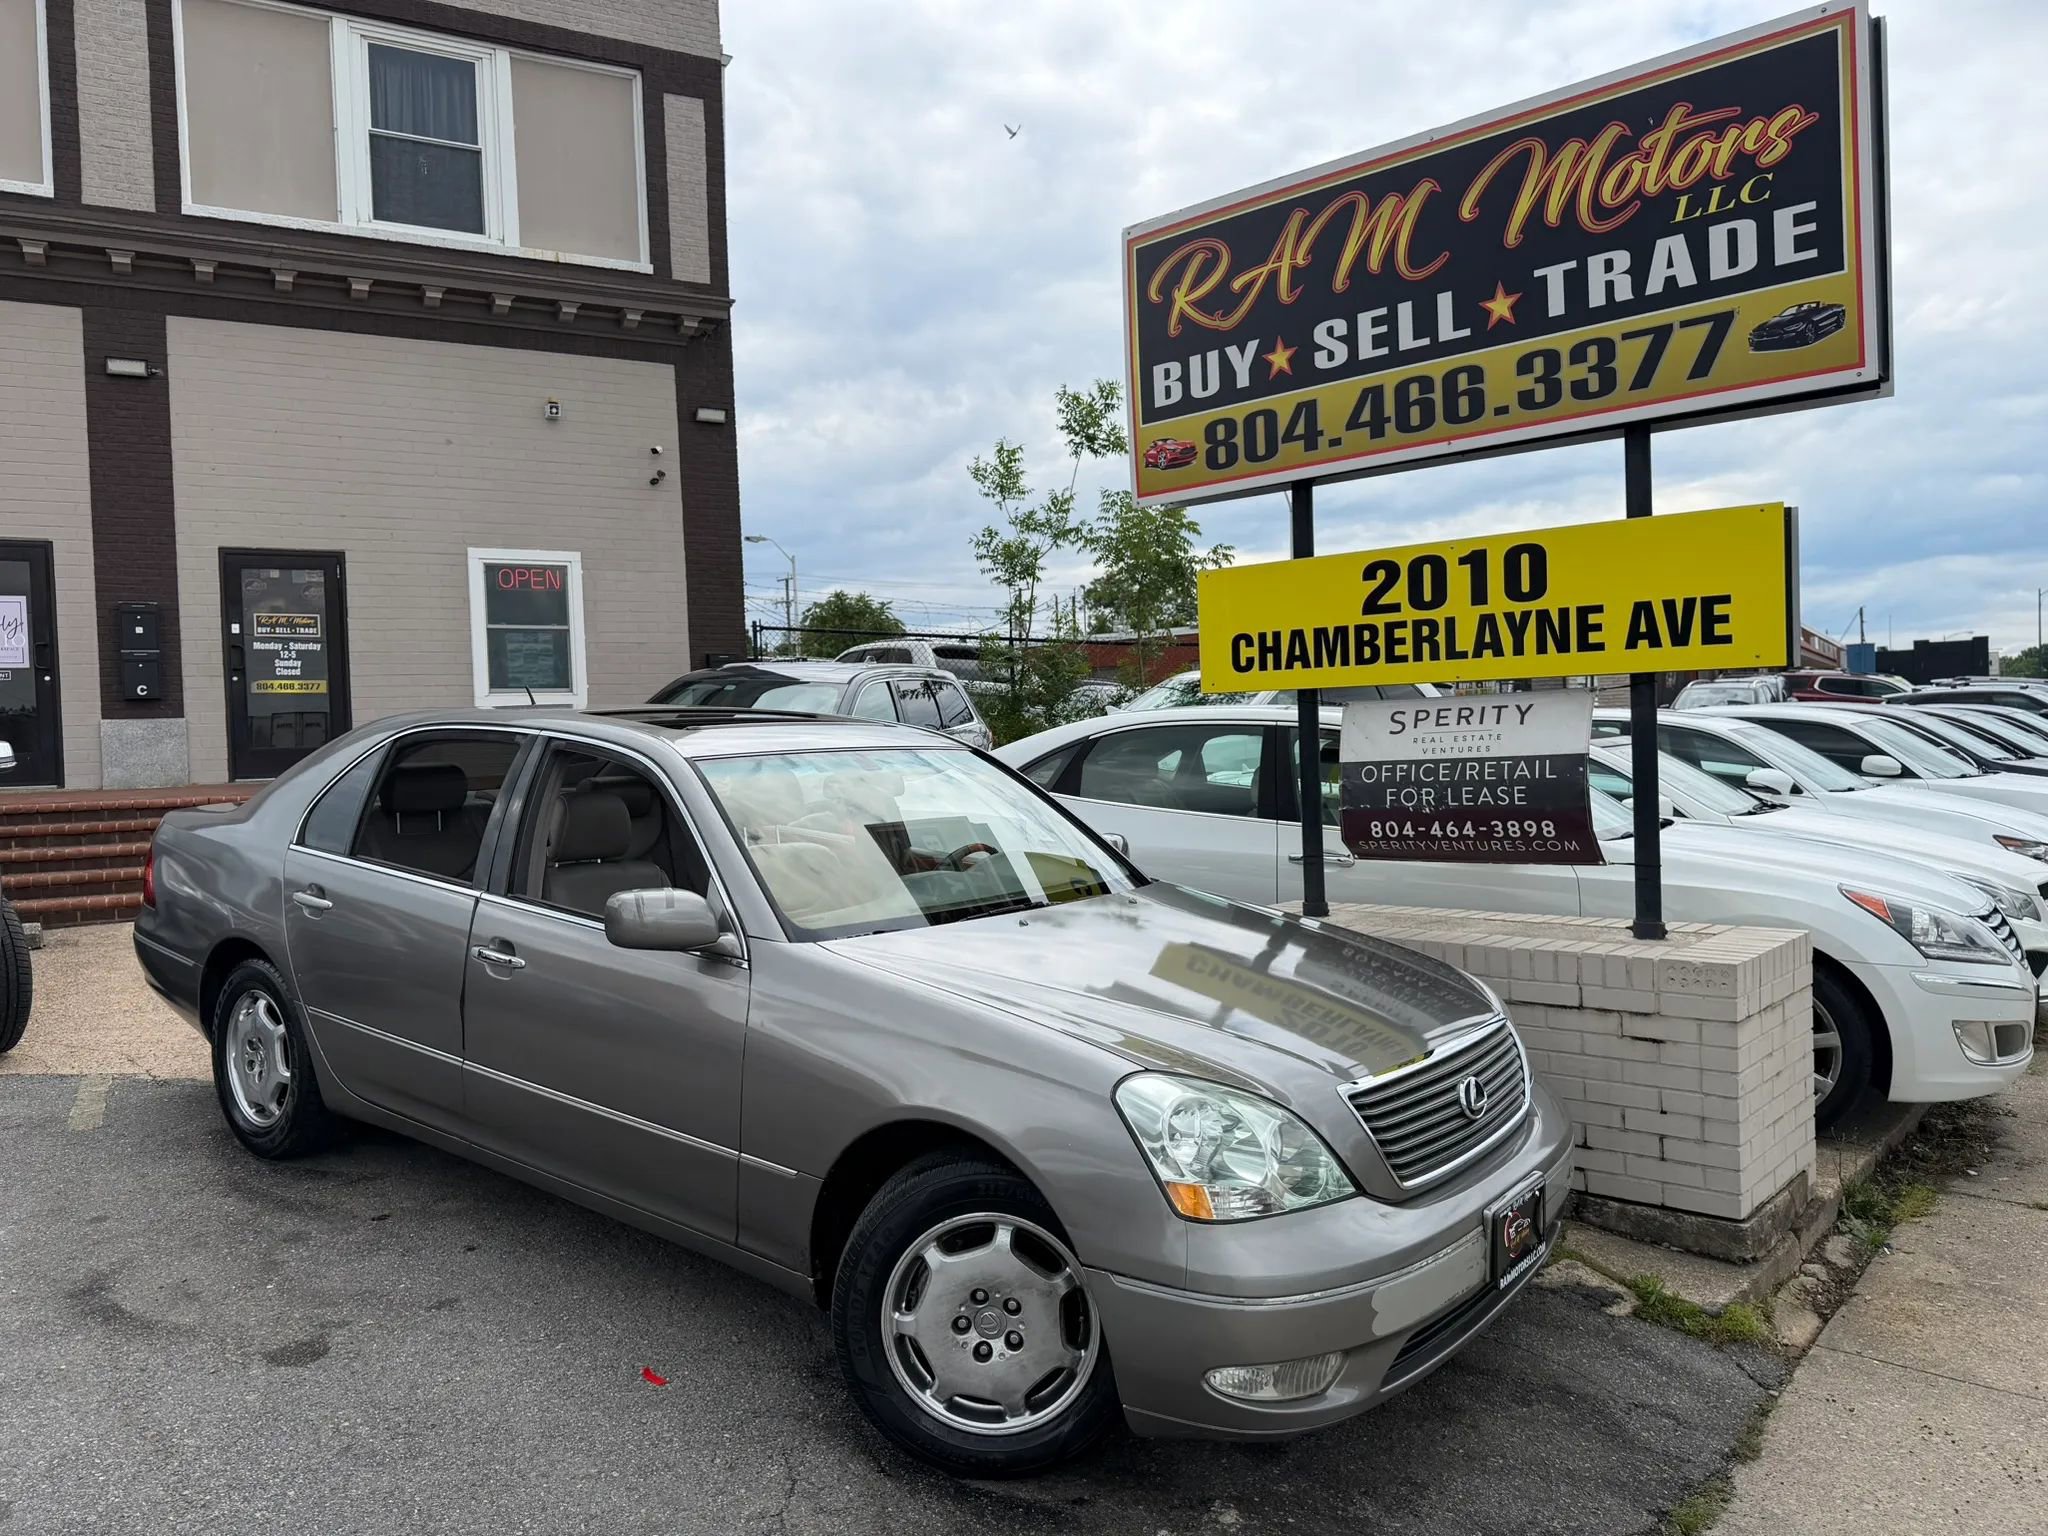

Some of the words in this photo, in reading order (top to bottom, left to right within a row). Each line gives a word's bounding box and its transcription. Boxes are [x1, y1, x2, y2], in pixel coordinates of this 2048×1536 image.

[1457, 102, 1819, 249] Motors
[1669, 173, 1775, 224] LLC
[1151, 339, 1260, 408] BUY
[1311, 291, 1472, 370] SELL
[1534, 200, 1819, 319] TRADE
[1204, 309, 1739, 471] 804.466.3377
[498, 568, 561, 590] OPEN
[1361, 543, 1548, 616] 2010
[1231, 604, 1606, 674] CHAMBERLAYNE
[1624, 594, 1733, 650] AVE
[253, 642, 282, 650] Monday
[289, 642, 321, 650] Saturday
[279, 651, 296, 659] 12-5
[274, 659, 302, 668] Sunday
[136, 685, 148, 695] C
[1389, 703, 1535, 736] SPERITY
[1413, 736, 1444, 745] REAL
[1453, 734, 1503, 743] ESTATE
[1422, 745, 1492, 755] VENTURES
[1361, 760, 1557, 783] OFFICE/RETAIL
[1386, 788, 1436, 807] FOR
[1448, 786, 1528, 806] LEASE
[1370, 820, 1556, 839] 804-464-3898
[1358, 840, 1580, 852] SPERITYVENTURES.COM
